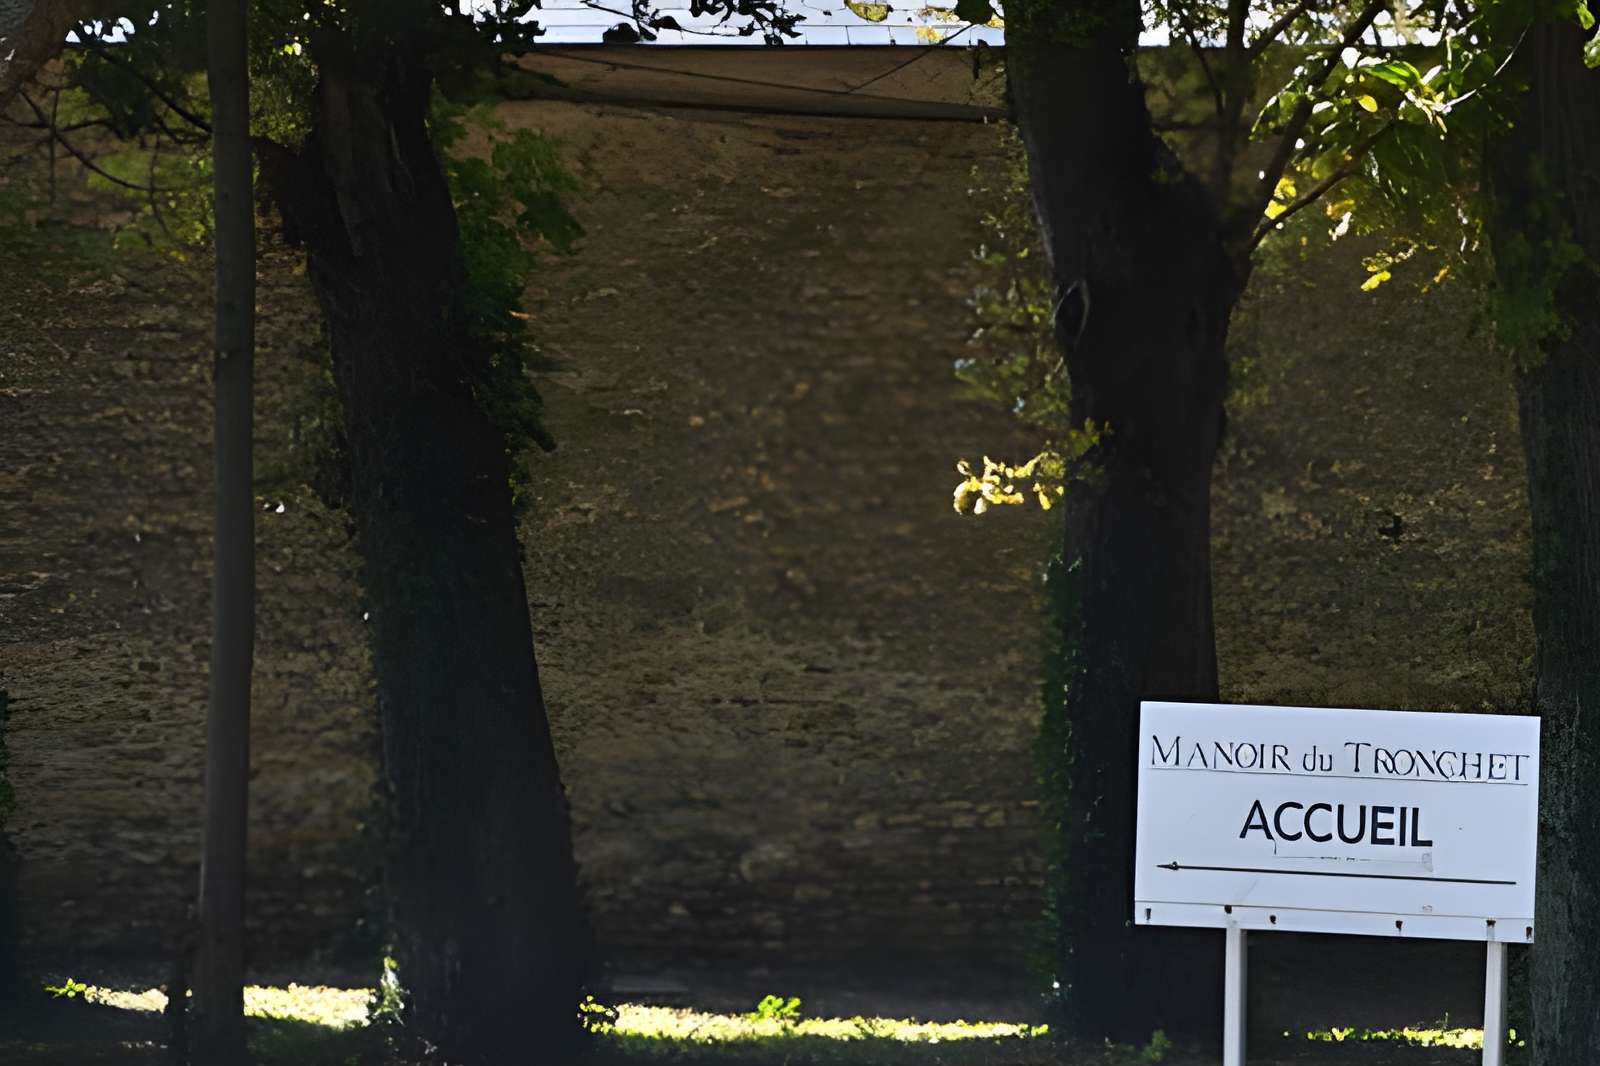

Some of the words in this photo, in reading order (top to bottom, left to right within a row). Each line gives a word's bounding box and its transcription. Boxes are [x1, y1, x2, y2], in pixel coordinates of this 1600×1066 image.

[1151, 735, 1291, 772] MANOIR
[1302, 745, 1333, 772] du
[1344, 742, 1530, 781] TRONCHET
[1239, 799, 1434, 847] ACCUEIL
